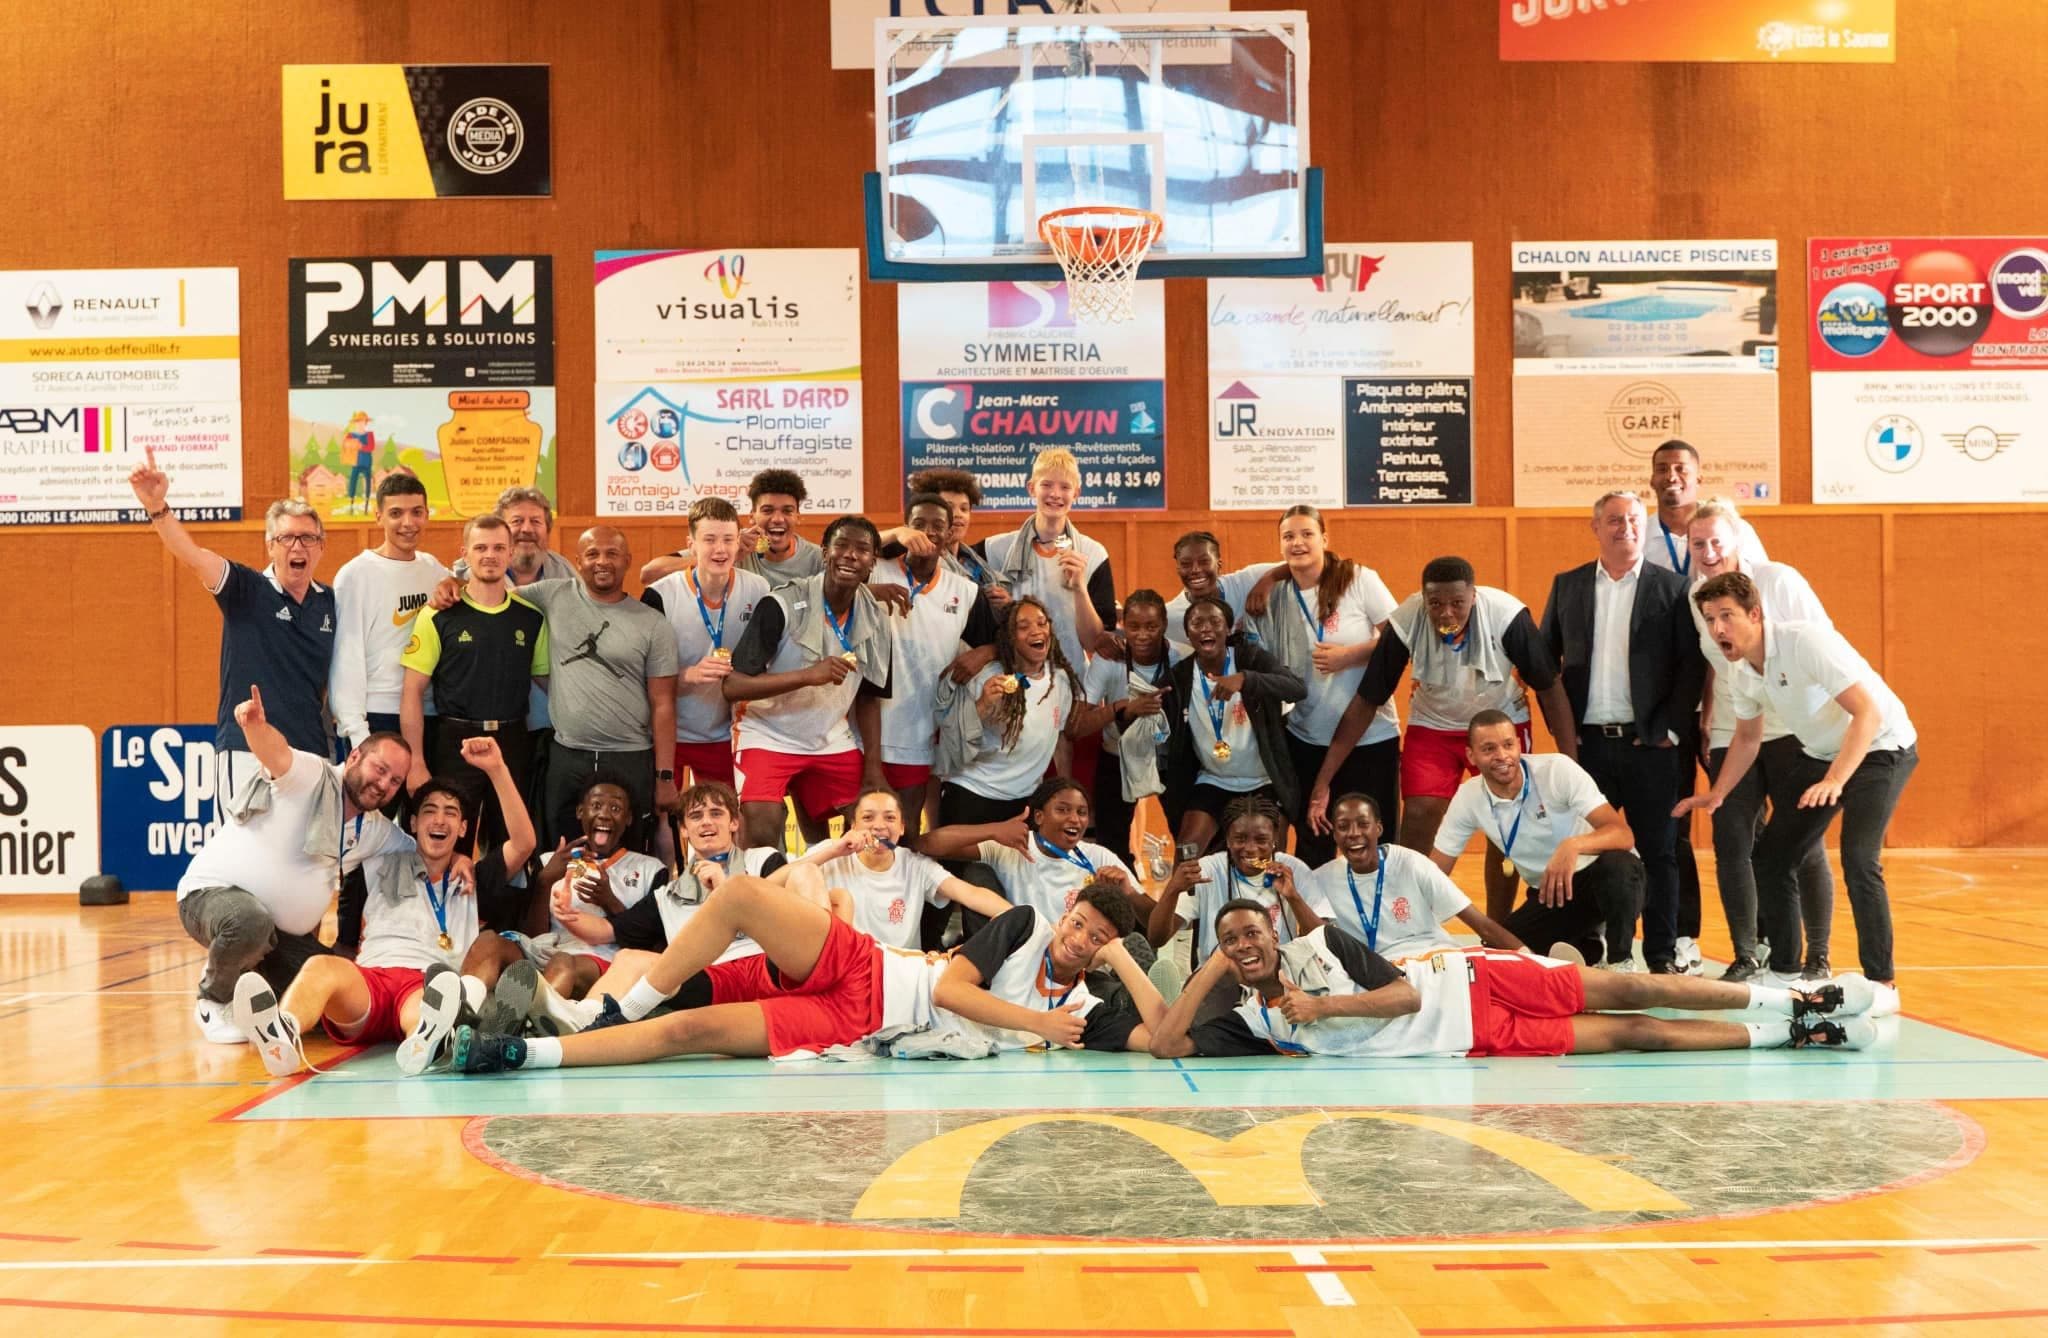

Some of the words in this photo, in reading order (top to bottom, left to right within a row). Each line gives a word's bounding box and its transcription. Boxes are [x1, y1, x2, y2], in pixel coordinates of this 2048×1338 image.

[456, 106, 499, 136] MADE
[469, 130, 502, 142] MEDIA
[462, 150, 508, 167] JURA
[1518, 250, 1591, 264] CHALON
[1598, 250, 1683, 263] ALLIANCE
[1689, 249, 1772, 262] PISCINES
[1851, 256, 1899, 275] magasin
[1893, 283, 1986, 304] SPORT
[73, 298, 160, 310] RENAULT
[306, 260, 536, 346] PMM
[657, 296, 800, 320] visualis
[1902, 306, 1978, 327] 2000
[329, 333, 419, 347] SYNERGIES
[426, 332, 437, 346] &
[444, 331, 536, 345] SOLUTIONS
[1822, 326, 1888, 338] montagne
[30, 343, 181, 357] www.auto-deffeuille.fr
[963, 343, 1101, 363] SYMMETRIA
[32, 371, 83, 382] SORECA
[87, 369, 180, 380] AUTOMOBILES
[937, 367, 1012, 377] ARCHITECTURE
[1015, 366, 1028, 376] ET
[1356, 383, 1402, 398] Plaque
[1405, 383, 1422, 396] de
[1424, 382, 1467, 398] plâtre,
[716, 388, 775, 410] SARL
[783, 387, 849, 409] DARD
[976, 394, 1059, 409] Jean-Marc
[1628, 397, 1664, 406] BISTROT
[1358, 400, 1466, 416] Aménagements,
[746, 415, 831, 430] Plombier
[970, 410, 1118, 436] CHAUVIN
[1382, 419, 1435, 432] intérieur
[1622, 416, 1670, 430] GARE
[132, 435, 165, 443] OFFSET
[180, 442, 219, 451] FORMAT
[726, 435, 852, 454] Chauffagiste
[1380, 434, 1438, 447] extérieur
[926, 443, 1015, 455] Plâtrerie-Isolation
[912, 456, 955, 466] Isolation
[957, 457, 975, 468] par
[977, 455, 1026, 466] l'extérieur
[1102, 454, 1115, 465] de
[1116, 454, 1156, 467] façades
[1382, 452, 1443, 466] Peinture,
[178, 463, 228, 471] documents
[1085, 473, 1101, 487] 84
[1104, 472, 1121, 487] 48
[1125, 472, 1141, 486] 35
[1144, 472, 1161, 486] 49
[1377, 469, 1449, 484] Terrasses,
[607, 484, 680, 498] Montaigu
[693, 482, 750, 497] Vatagn
[634, 500, 652, 511] 03
[656, 500, 674, 511] 84
[816, 499, 835, 509] 44
[838, 498, 852, 508] 17
[20, 511, 50, 523] LONS
[53, 511, 67, 523] LE
[69, 510, 120, 523] SAUNIER
[128, 508, 149, 521] Tél.
[183, 508, 197, 520] 86
[200, 507, 214, 520] 14
[216, 507, 231, 519] 14
[398, 593, 428, 612] JUMP
[113, 729, 145, 768] Le
[149, 727, 216, 820] Sp
